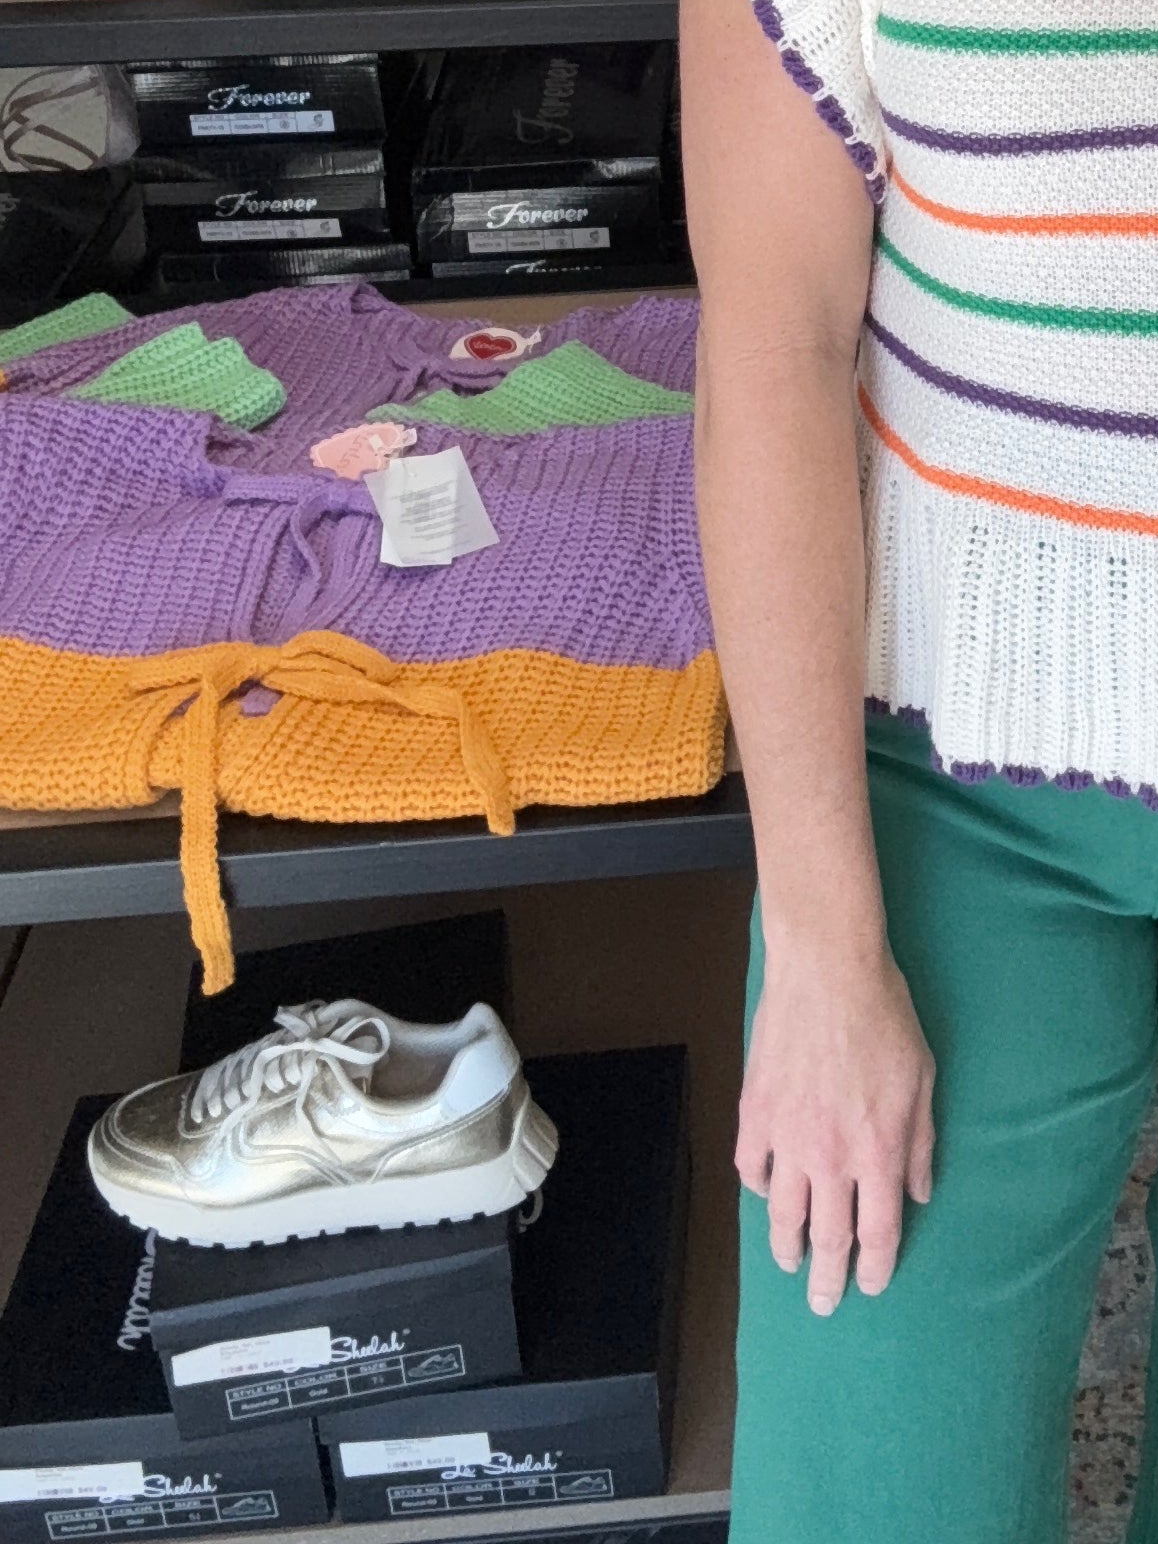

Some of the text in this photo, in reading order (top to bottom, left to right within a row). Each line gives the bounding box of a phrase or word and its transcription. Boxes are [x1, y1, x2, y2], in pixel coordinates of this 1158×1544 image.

[208, 83, 311, 112] Forever
[512, 58, 580, 144] Forever
[215, 190, 318, 217] Forever
[487, 200, 589, 229] Forever
[329, 1329, 405, 1363] Sheelah
[482, 1451, 558, 1475] Sheelah
[143, 1473, 218, 1498] Sheelah
